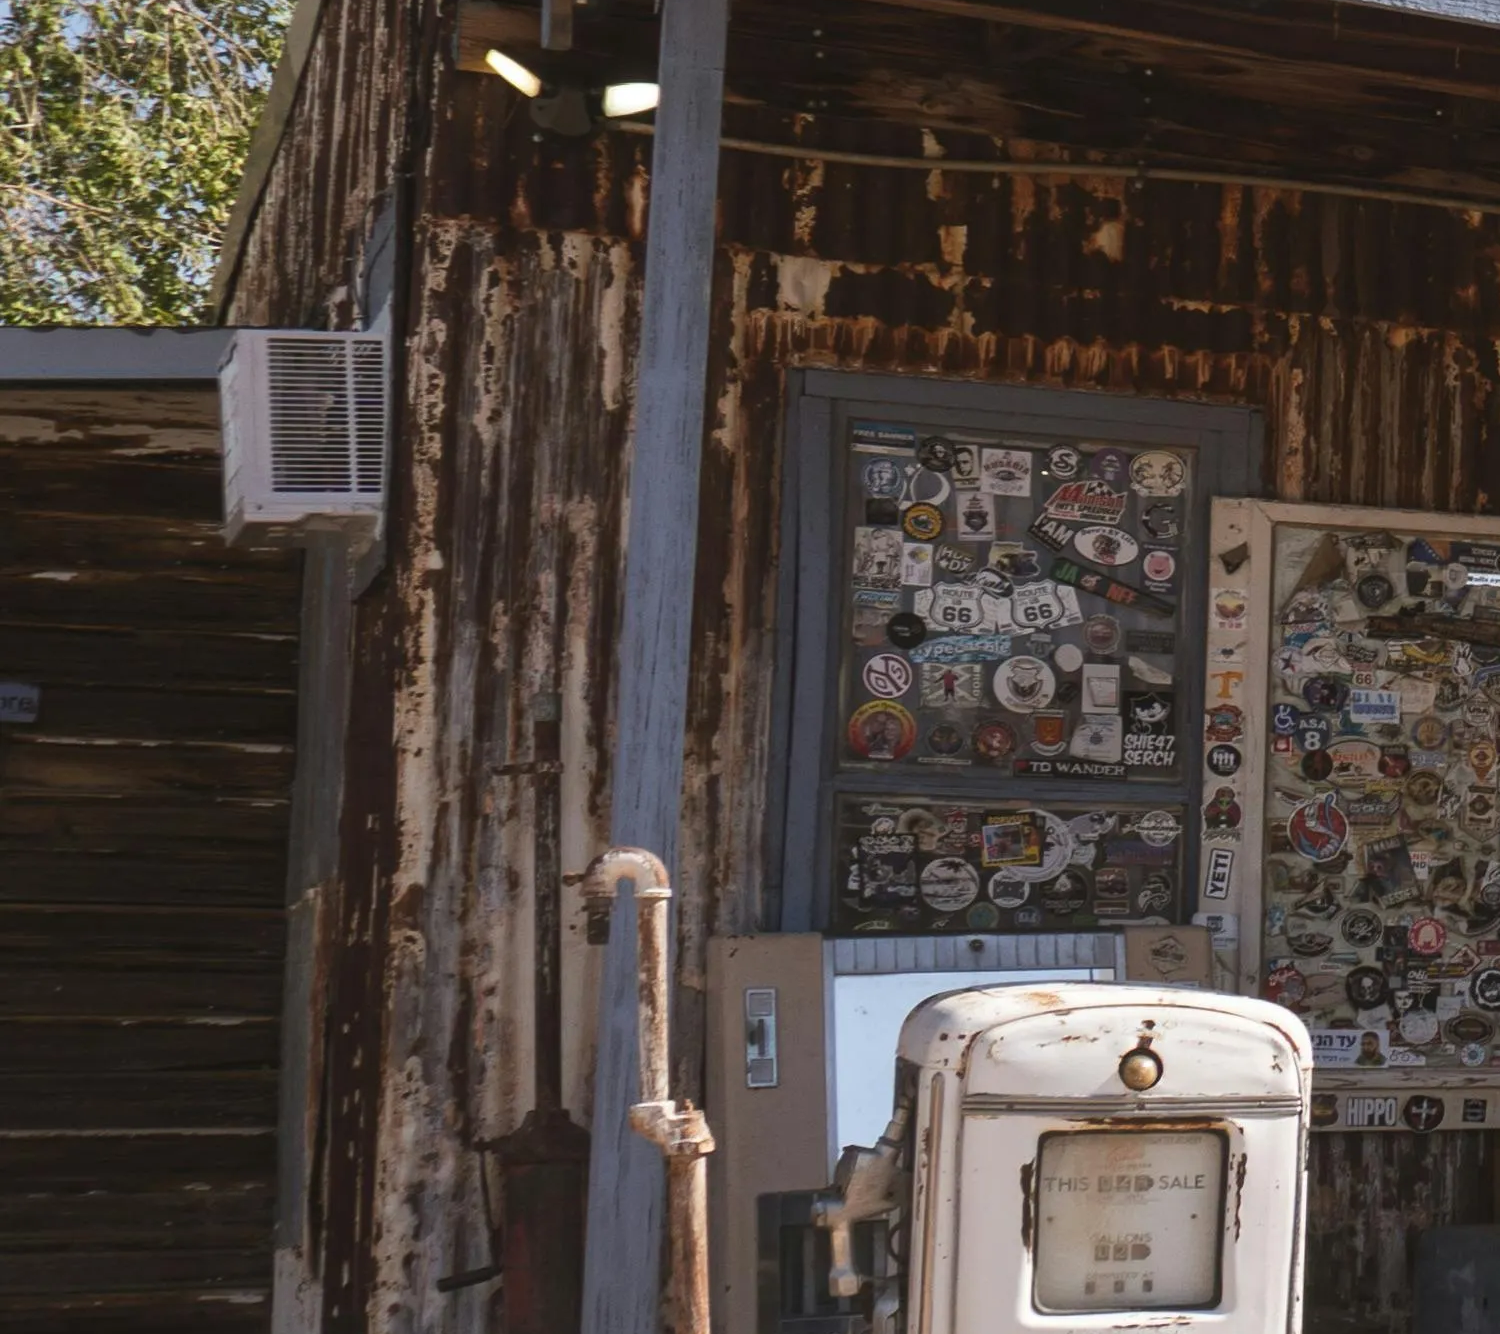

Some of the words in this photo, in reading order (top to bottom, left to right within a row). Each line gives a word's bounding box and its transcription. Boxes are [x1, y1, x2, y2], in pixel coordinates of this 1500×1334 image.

[942, 605, 972, 623] 66
[1023, 603, 1053, 623] 66
[1356, 673, 1373, 687] 66
[1298, 718, 1328, 730] ASA
[1304, 732, 1321, 750] 8
[1055, 761, 1126, 777] WANDER
[1209, 853, 1229, 895] YETI
[1347, 1098, 1397, 1126] HIPPO
[1043, 1177, 1090, 1193] THIS
[1158, 1174, 1207, 1191] SALE
